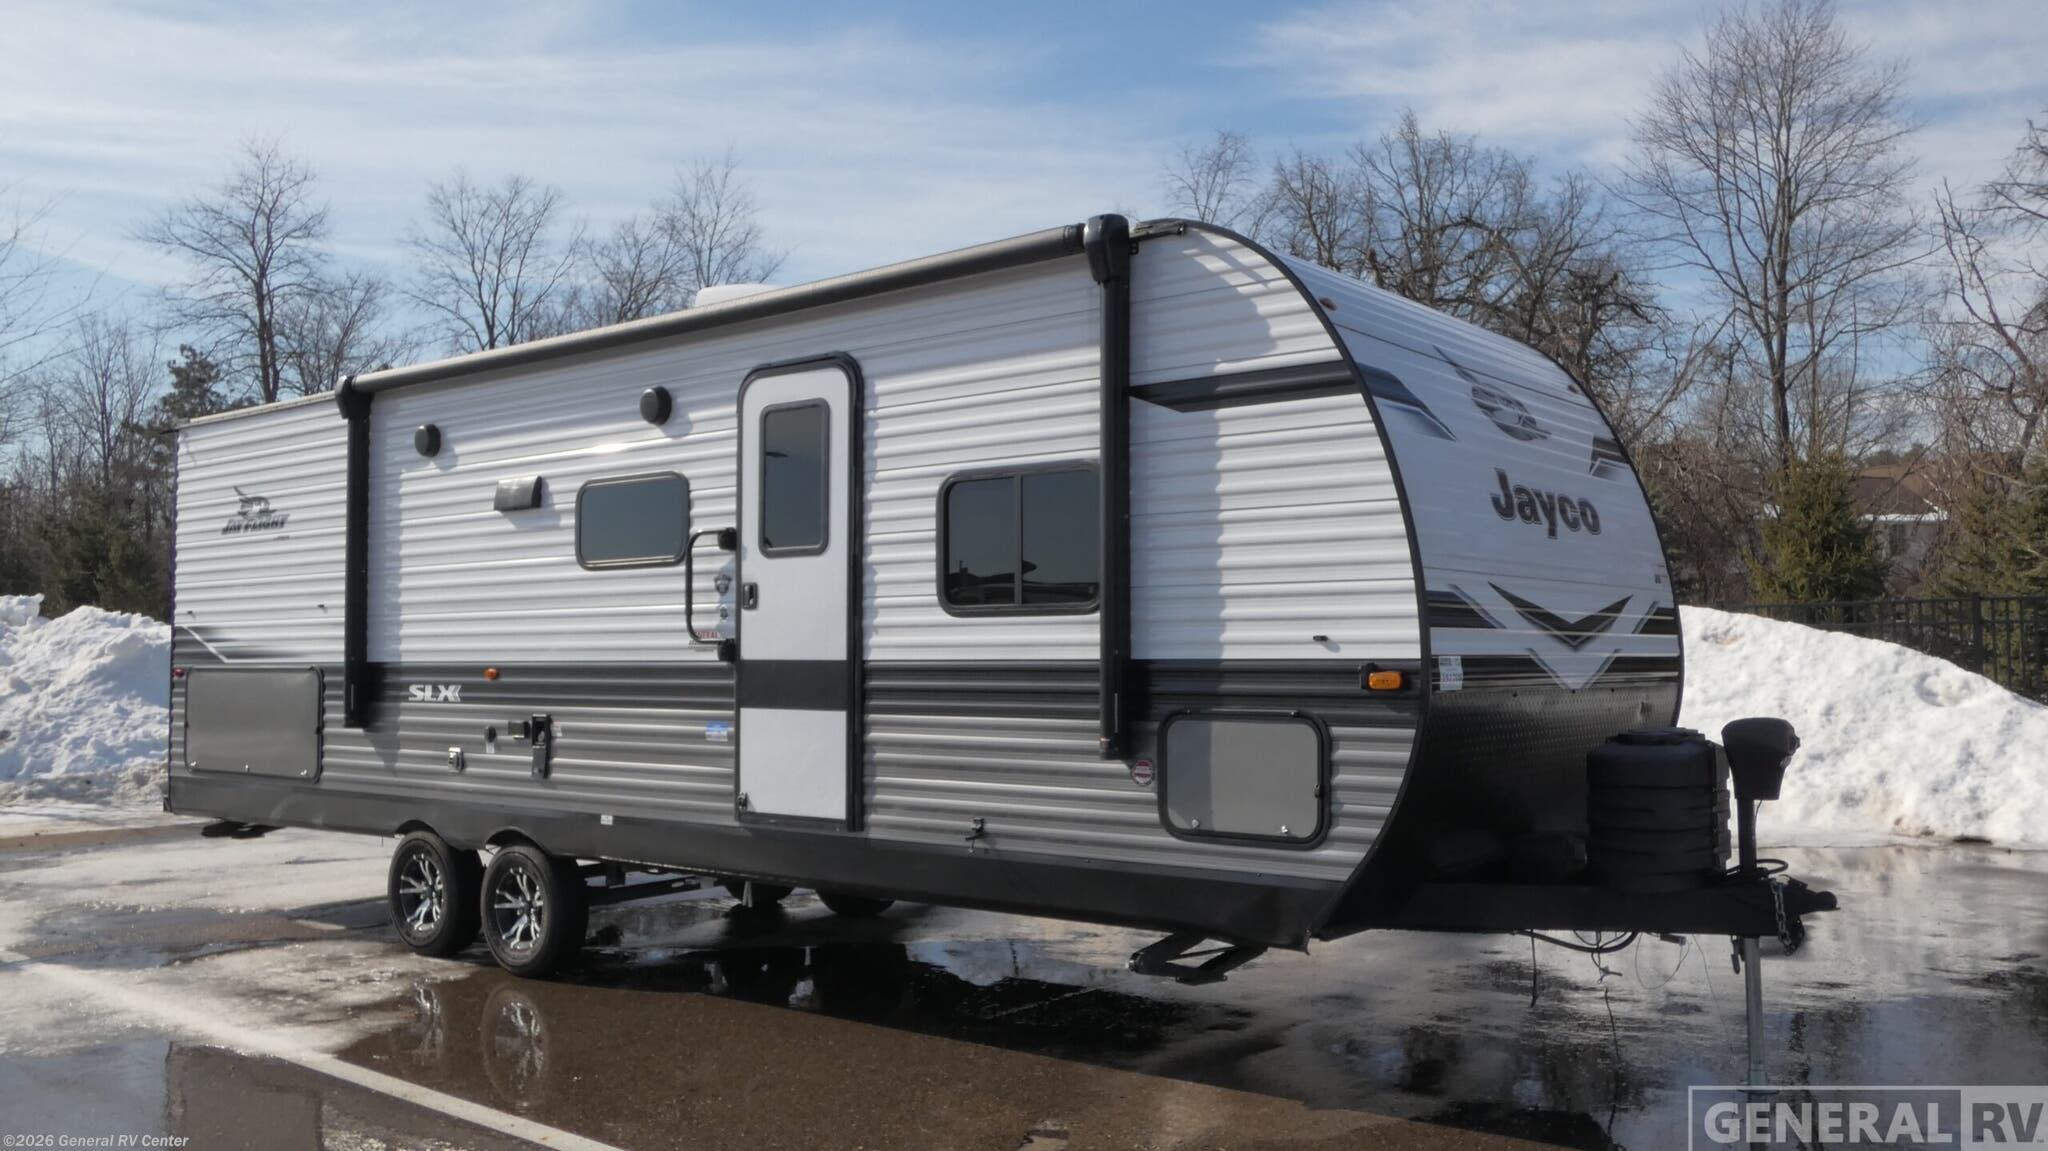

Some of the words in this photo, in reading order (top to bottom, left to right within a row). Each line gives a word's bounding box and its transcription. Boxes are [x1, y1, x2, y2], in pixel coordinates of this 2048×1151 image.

[1489, 467, 1601, 540] Jayco
[243, 513, 290, 532] FLIGHT
[408, 684, 462, 702] SLX
